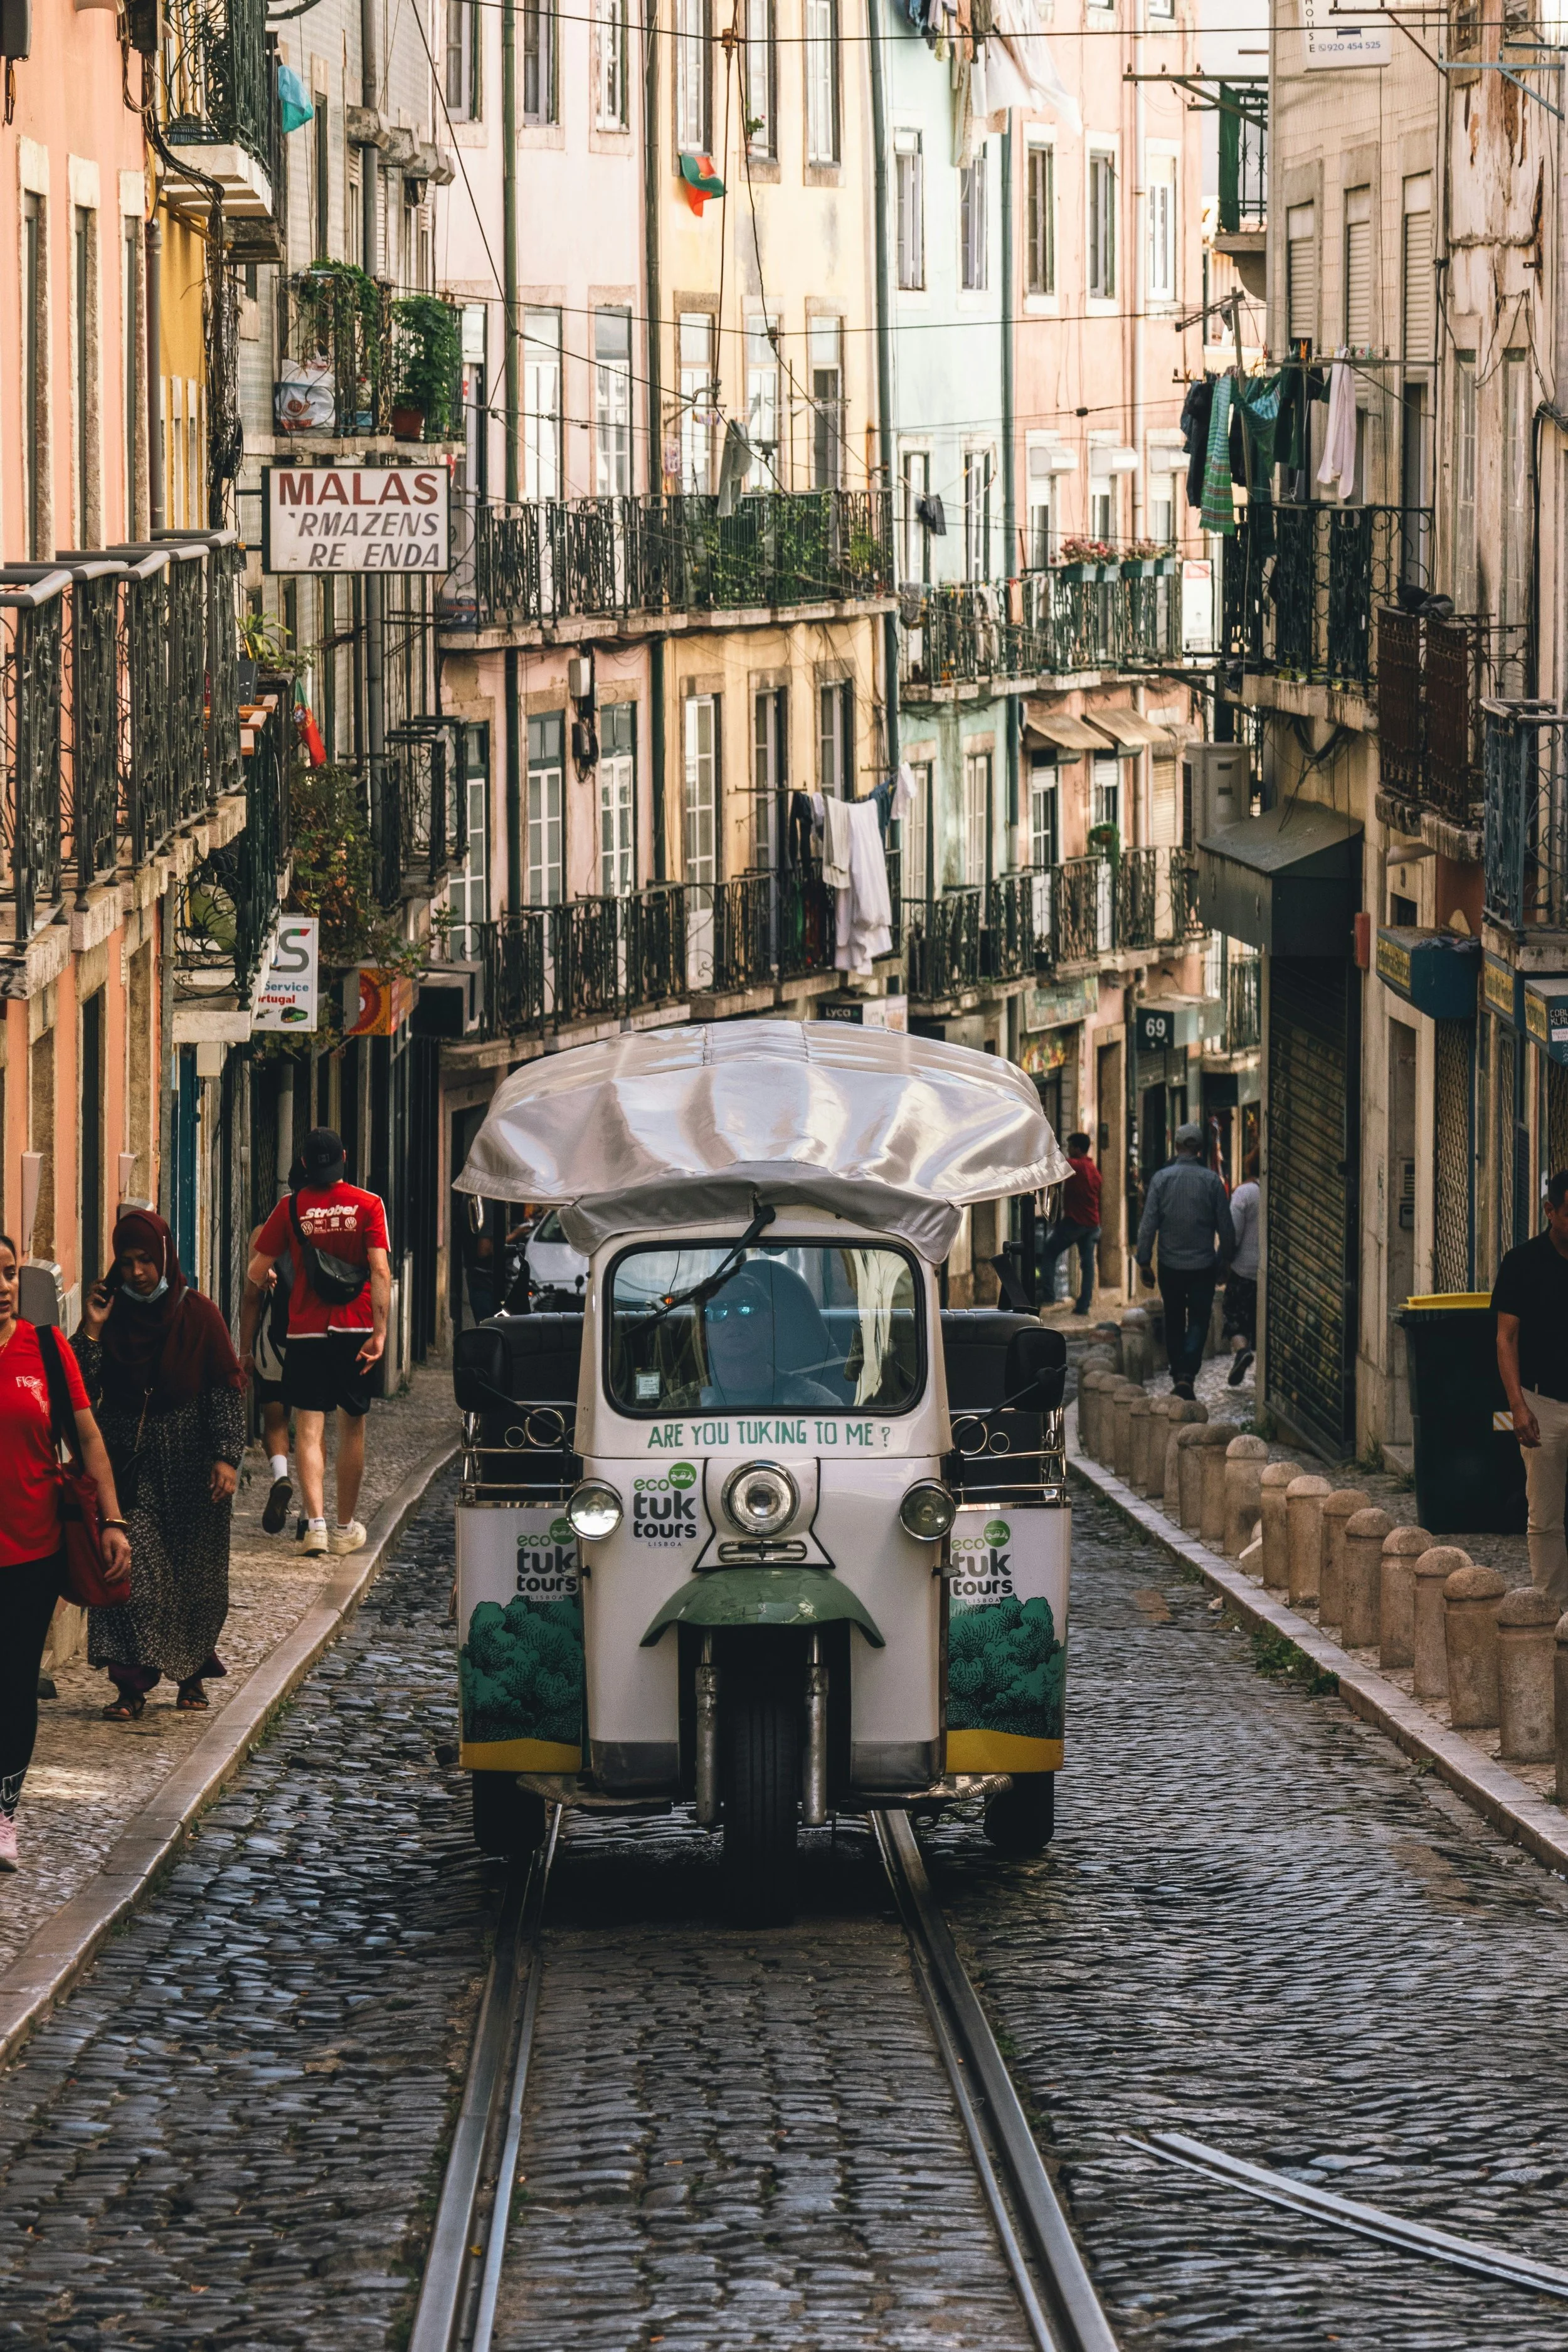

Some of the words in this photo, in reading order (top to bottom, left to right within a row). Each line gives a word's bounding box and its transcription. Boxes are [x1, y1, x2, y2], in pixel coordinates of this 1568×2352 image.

[279, 473, 438, 506] MALAS
[288, 512, 440, 537] RMAZENS
[265, 981, 309, 992] Service
[825, 1006, 851, 1018] Lyca
[1145, 1017, 1166, 1038] 69
[302, 1204, 359, 1219] Strobel
[647, 1423, 684, 1448] ARE
[691, 1422, 729, 1446] YOU
[736, 1419, 807, 1444] TUKING
[814, 1421, 837, 1445] TO
[845, 1422, 874, 1446] ME
[633, 1479, 669, 1491] eco
[633, 1490, 696, 1520] tuk
[633, 1520, 696, 1539] tours
[517, 1535, 551, 1547] eco
[951, 1539, 985, 1550] eco
[517, 1545, 576, 1574] tuk
[951, 1549, 1012, 1577] tuk
[517, 1575, 576, 1592] tours
[953, 1579, 1013, 1596] tours
